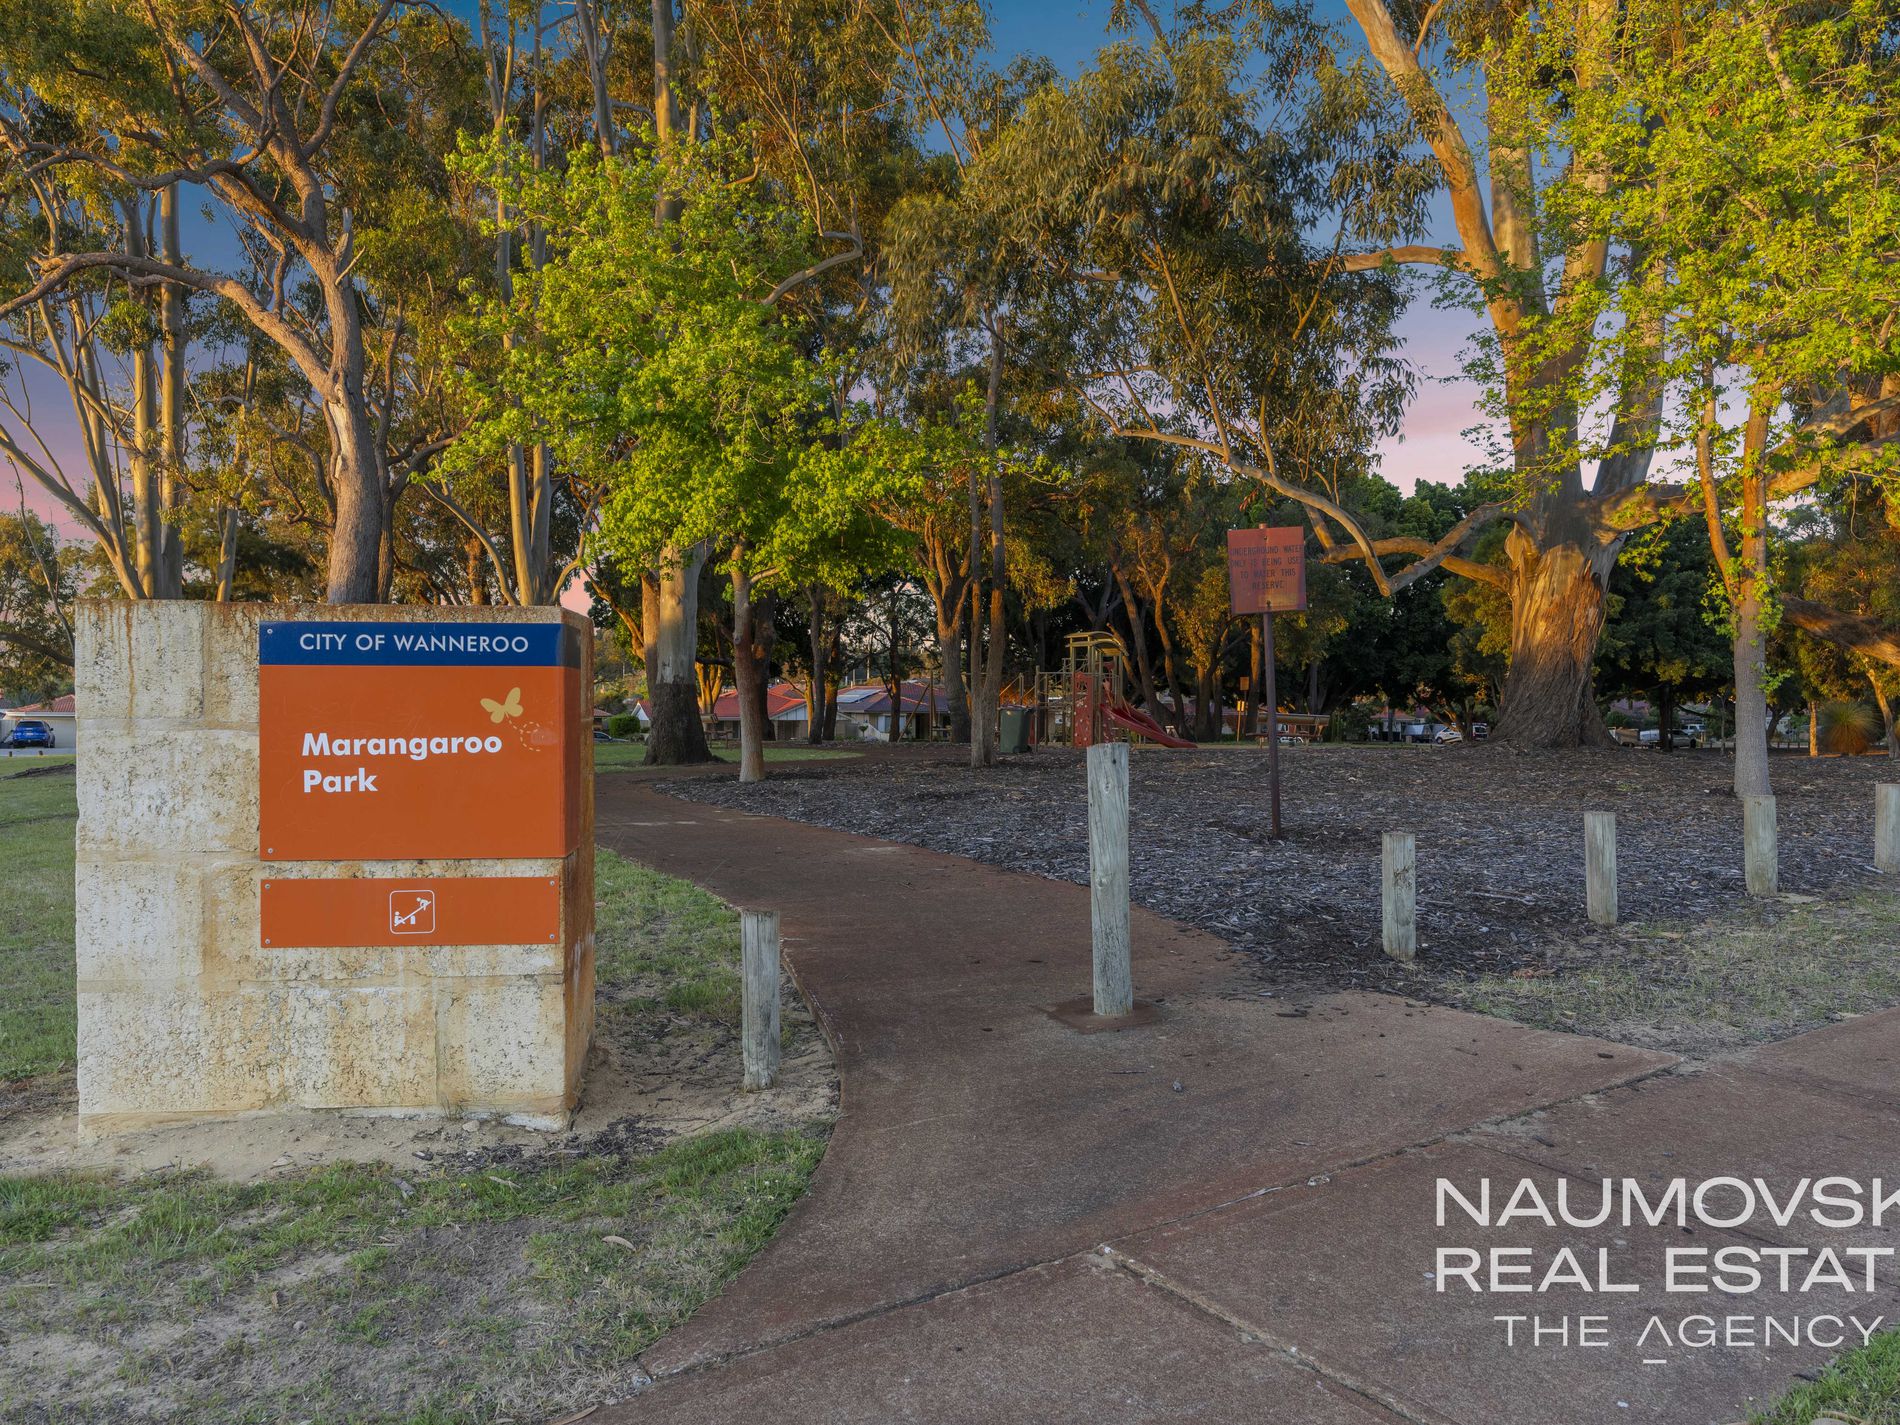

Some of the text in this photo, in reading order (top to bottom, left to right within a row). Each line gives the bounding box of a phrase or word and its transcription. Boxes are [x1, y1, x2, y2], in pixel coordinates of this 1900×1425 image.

[1281, 568, 1296, 577] THIS
[300, 633, 529, 653] CITY OF WANNEROO
[302, 732, 503, 761] Marangaroo
[303, 768, 378, 793] Park
